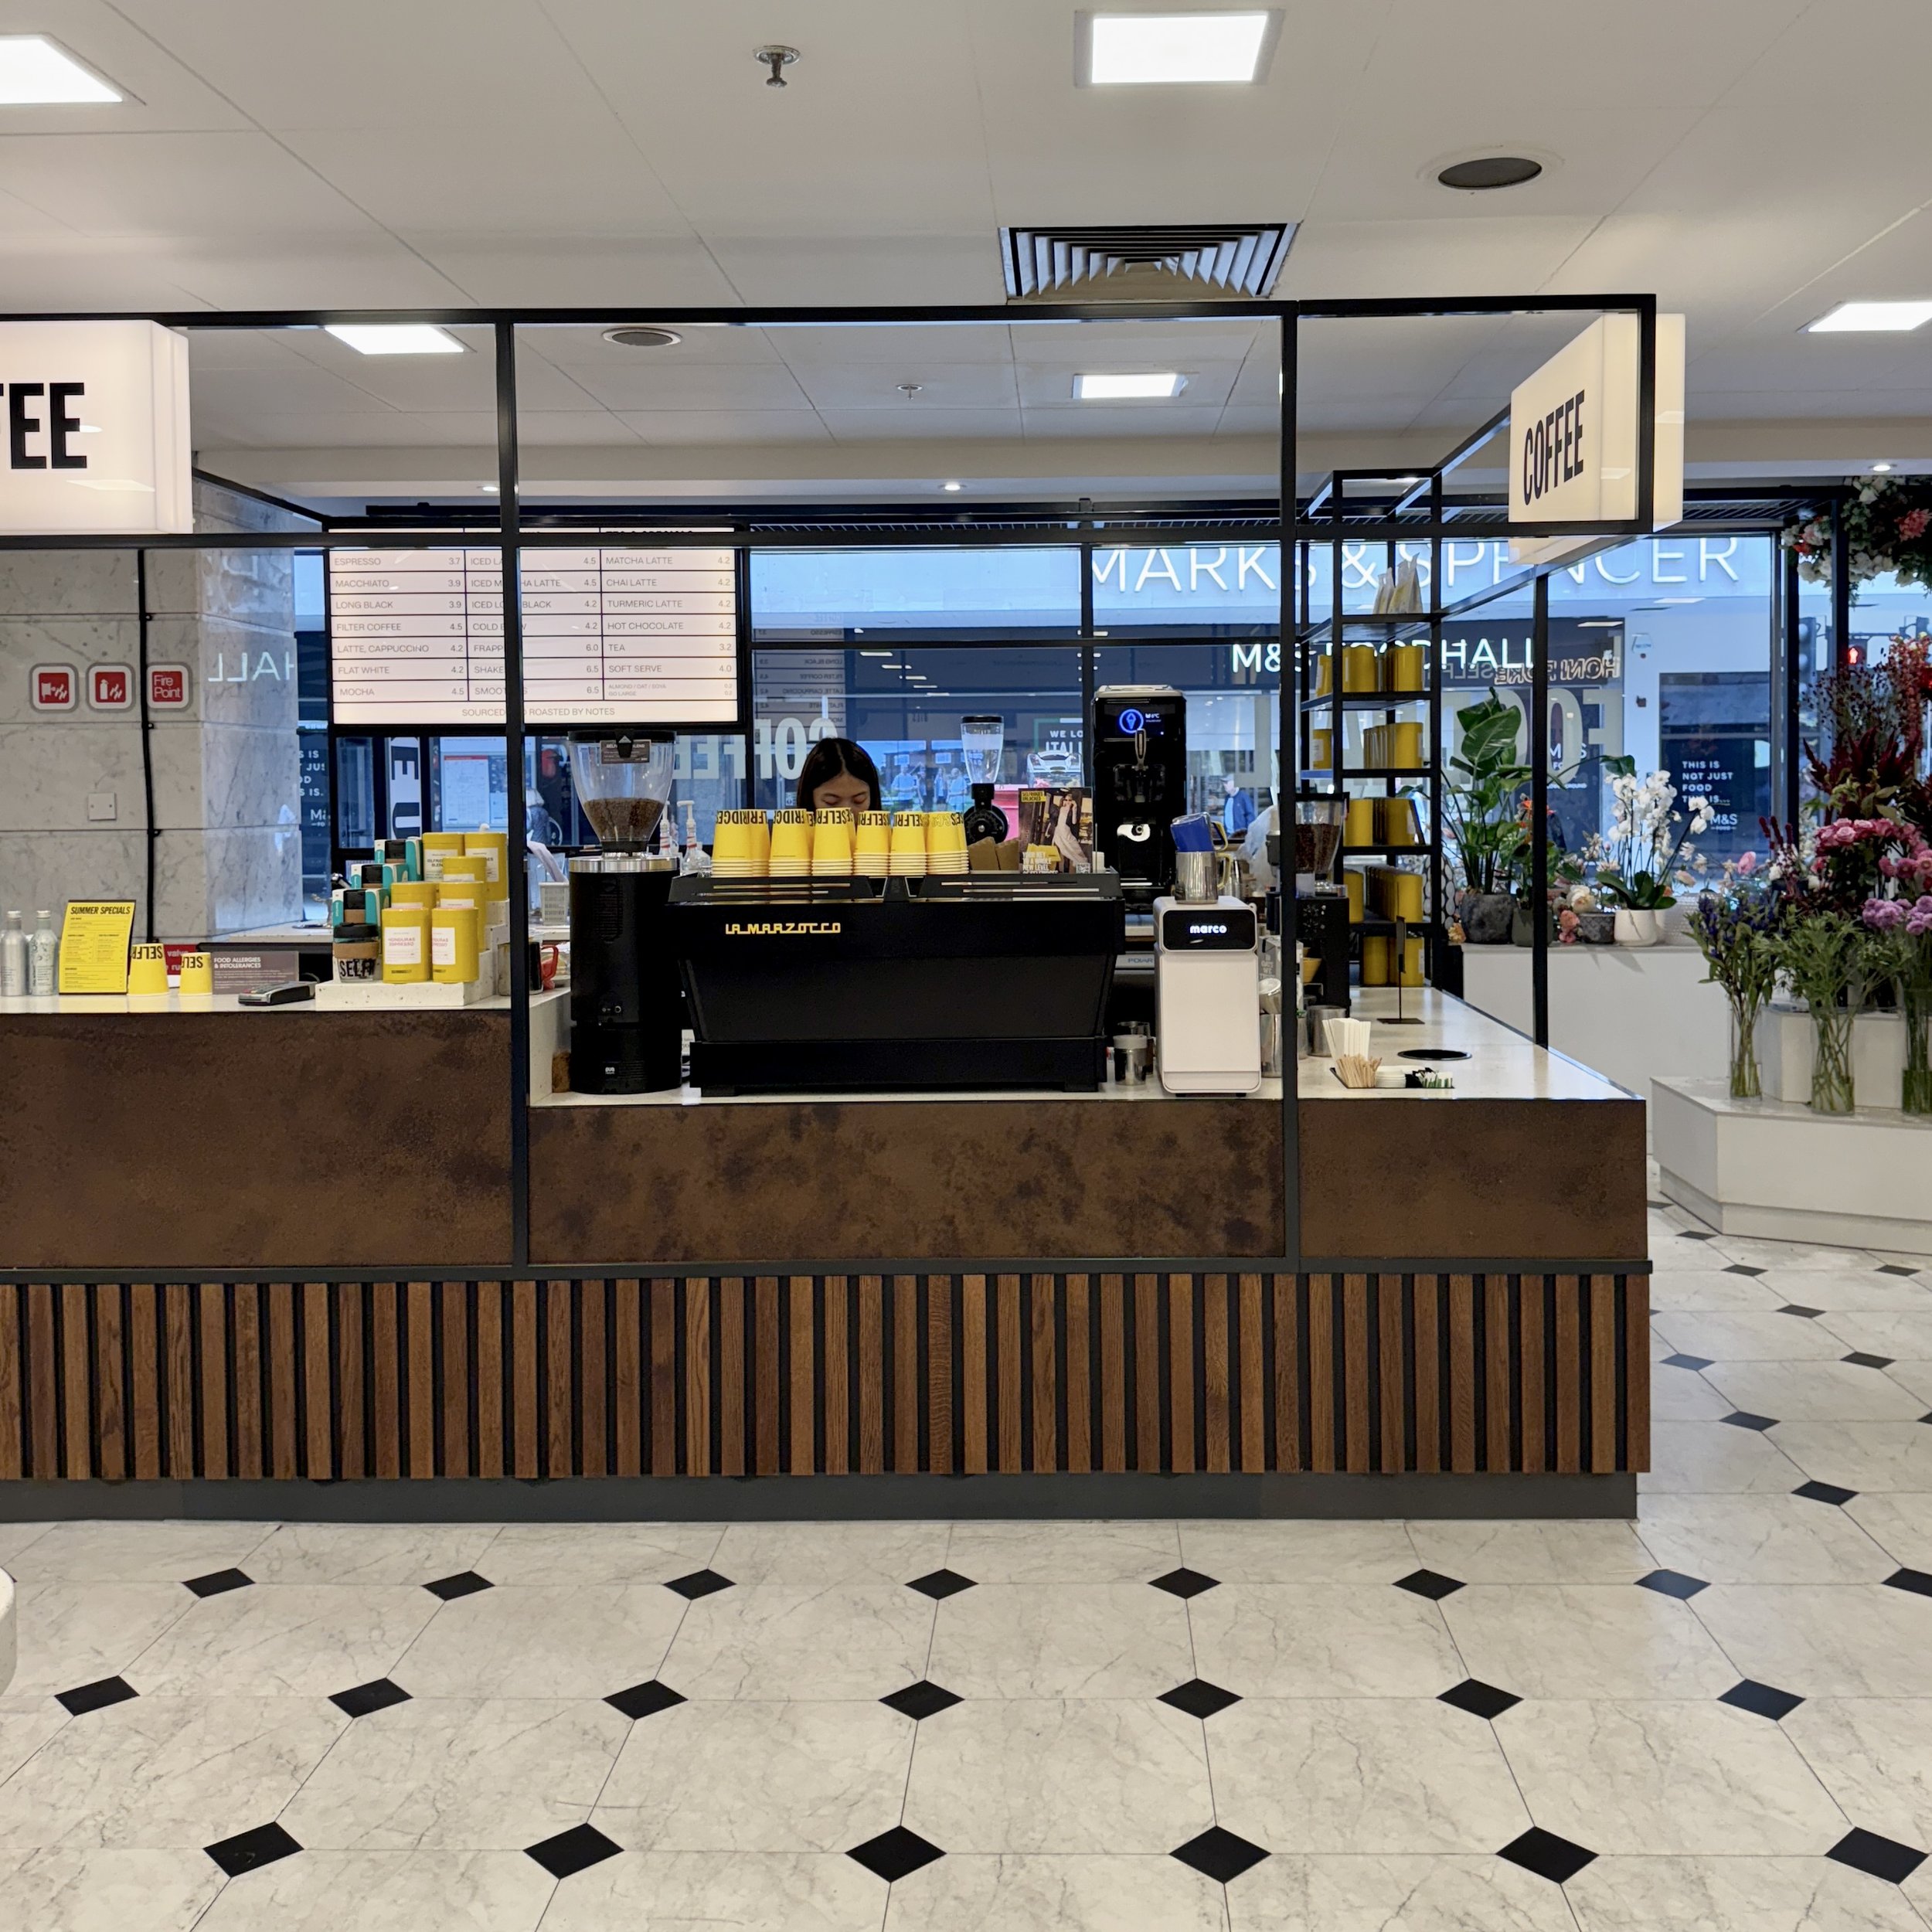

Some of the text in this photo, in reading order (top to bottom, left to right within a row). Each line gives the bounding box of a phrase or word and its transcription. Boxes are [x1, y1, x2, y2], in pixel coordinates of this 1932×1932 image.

[1523, 389, 1585, 505] COFFEE
[334, 557, 461, 566] ESPRESSO 3.7
[470, 557, 492, 566] ICED
[1342, 543, 1381, 589] &
[448, 579, 461, 587] 3.9
[335, 600, 462, 610] LONG BLACK 3.9
[471, 600, 493, 609] ICED
[522, 600, 552, 609] BLACK
[336, 623, 365, 631] FILTER
[367, 623, 402, 631] COFFEE
[368, 645, 430, 653] CAPPUCCINO
[450, 644, 464, 652] 4.2
[719, 643, 733, 651] 3.2
[338, 666, 359, 675] FLAT
[361, 666, 390, 675] WHITE
[154, 675, 174, 687] Fire
[154, 686, 182, 699] Point
[451, 687, 465, 696] 4.5
[1049, 730, 1066, 738] WE
[1682, 760, 1720, 770] THIS IS
[1682, 772, 1733, 781] NOT JUST
[1682, 784, 1713, 792] FOOD
[1709, 813, 1738, 825] M&S
[70, 906, 131, 915] SUMMER SPECIALS
[725, 923, 740, 935] LA
[1189, 923, 1227, 934] marco
